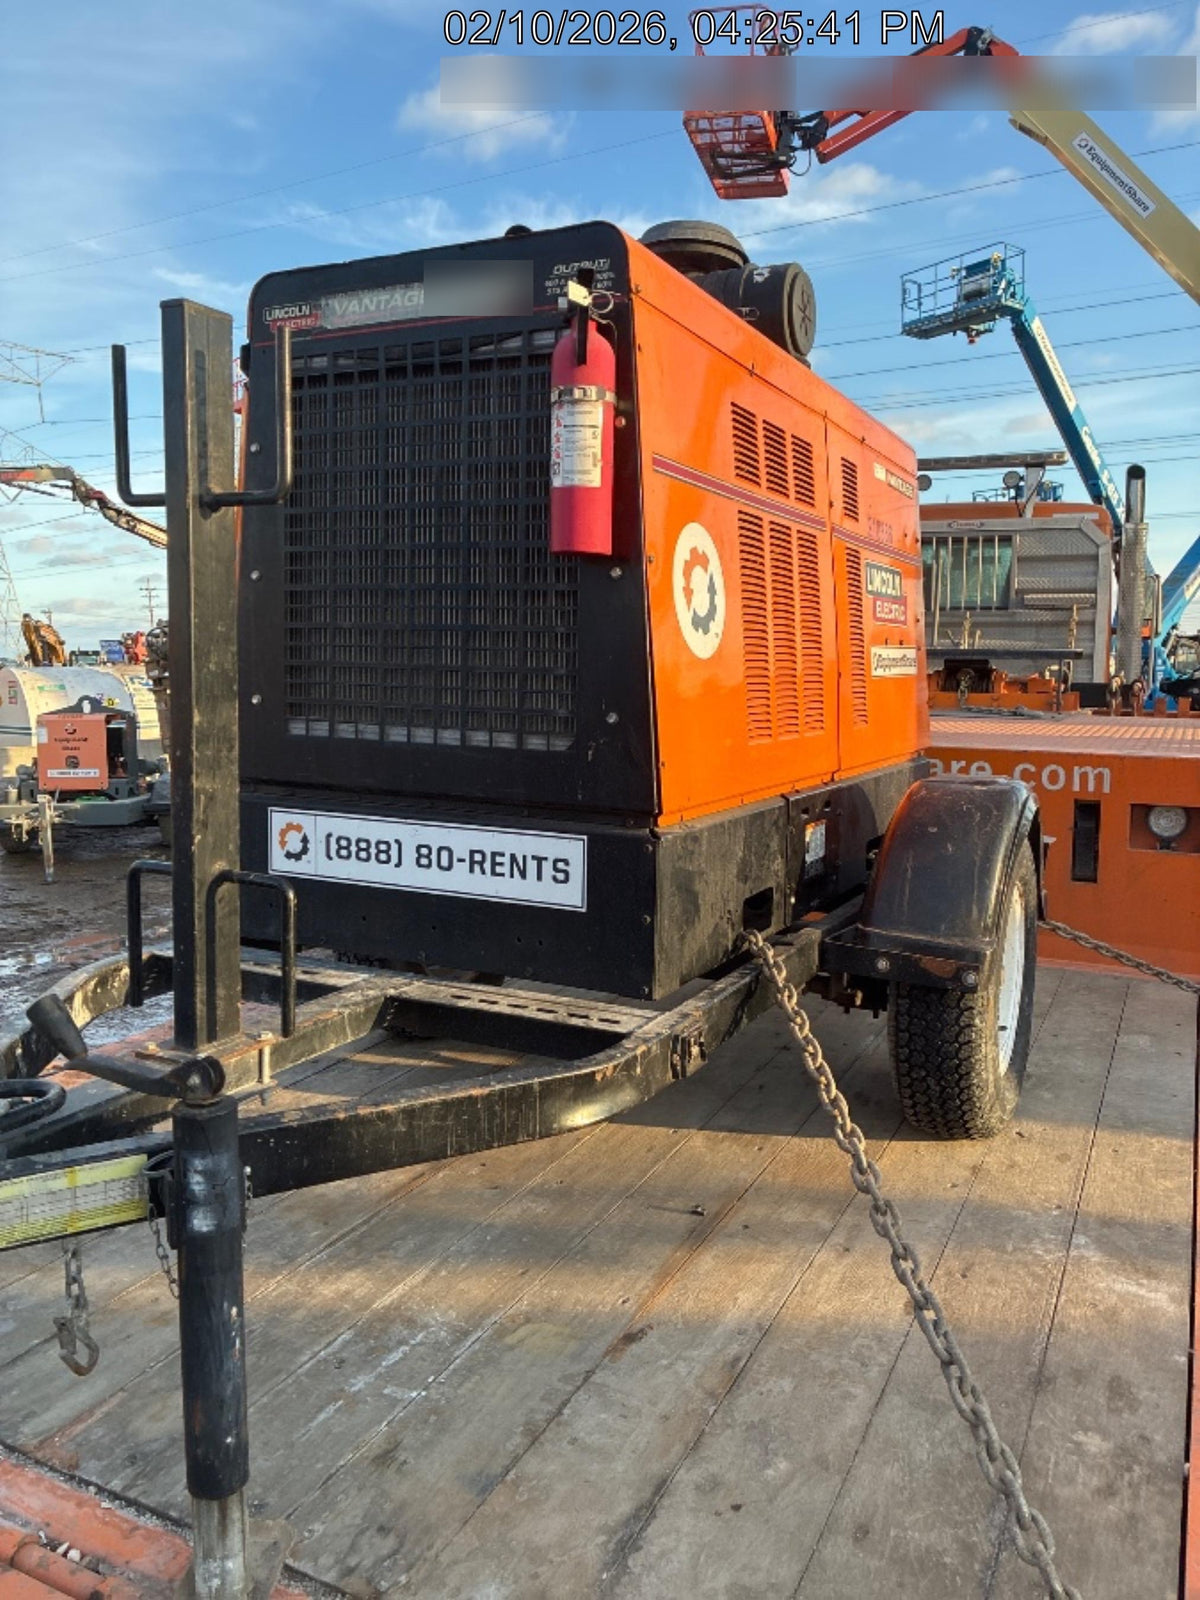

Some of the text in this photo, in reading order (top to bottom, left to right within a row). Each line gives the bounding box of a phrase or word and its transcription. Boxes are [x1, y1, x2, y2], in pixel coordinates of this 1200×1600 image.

[265, 304, 311, 321] LINCOLN
[333, 288, 425, 316] VANTAG
[867, 566, 901, 597] LINCOLN
[324, 832, 572, 885] (888) 80-RENTS
